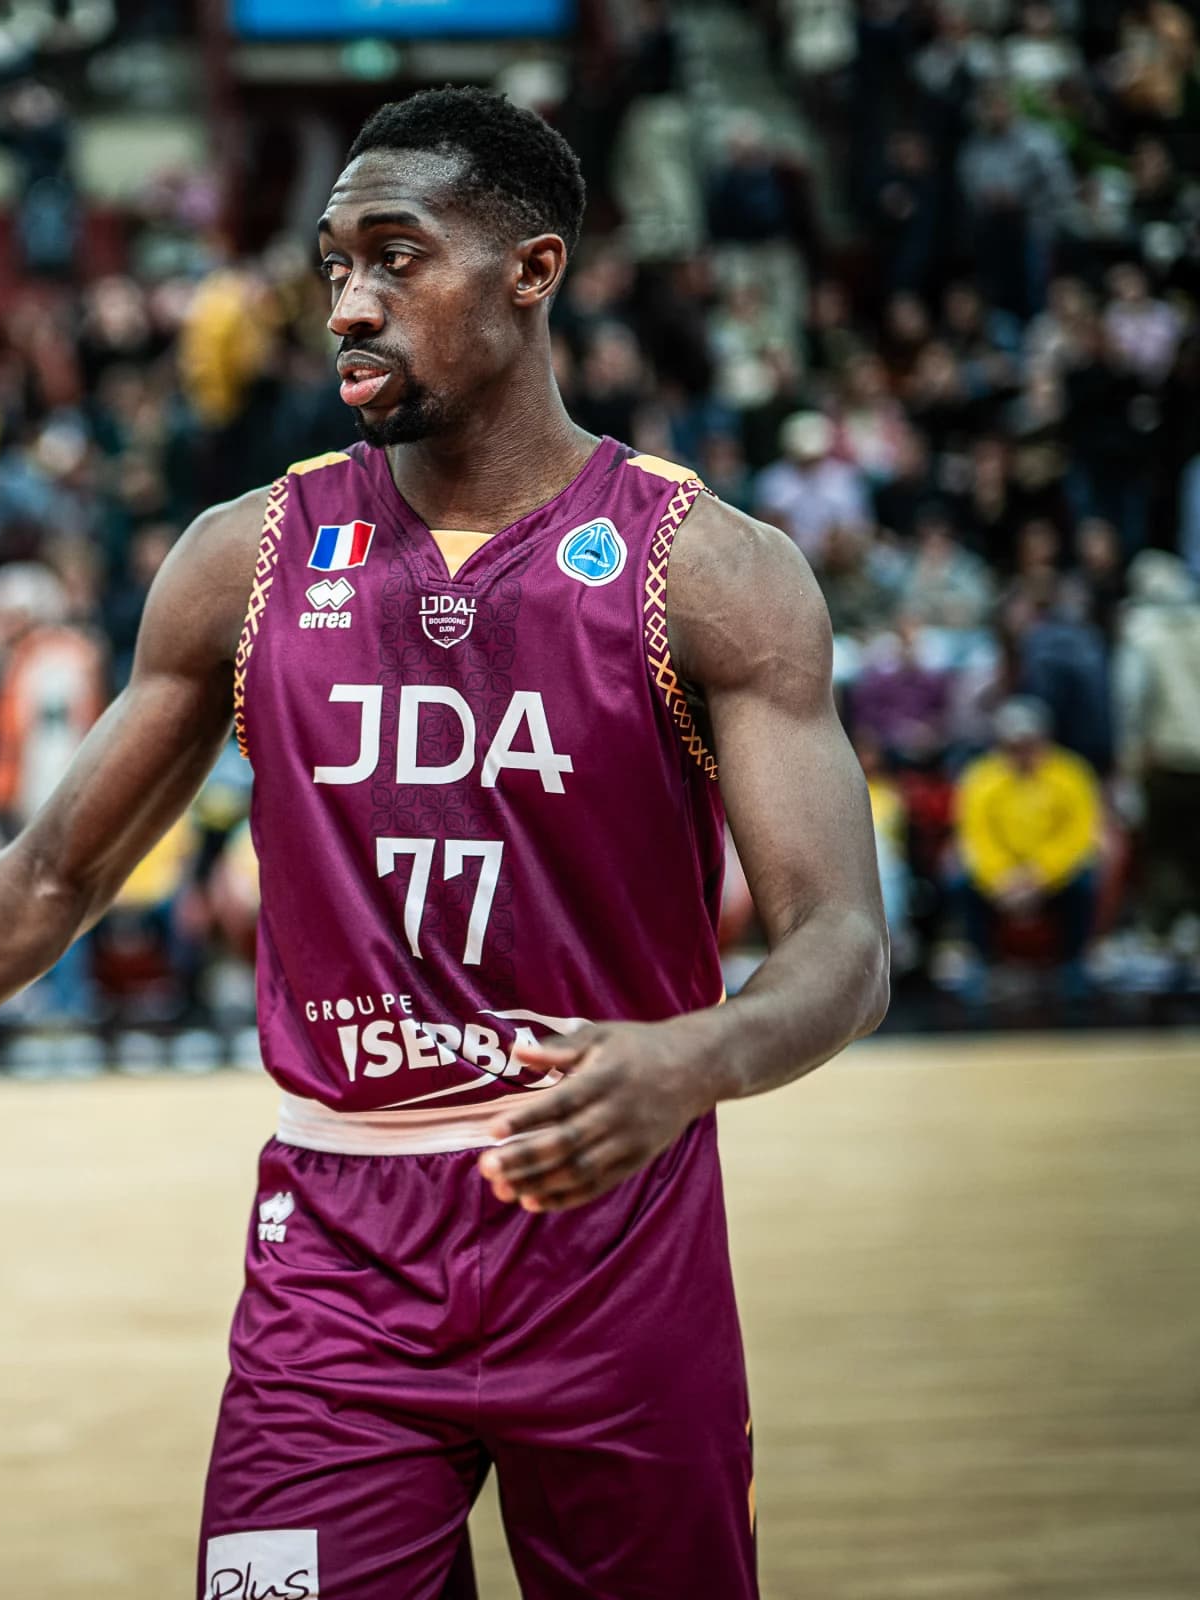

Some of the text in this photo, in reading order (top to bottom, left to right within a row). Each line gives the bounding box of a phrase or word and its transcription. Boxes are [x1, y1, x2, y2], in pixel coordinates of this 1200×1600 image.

[299, 611, 352, 629] errea
[313, 684, 574, 794] JDA
[376, 837, 504, 965] 77
[305, 993, 413, 1022] GROUPE
[211, 1561, 310, 1600] Plus
